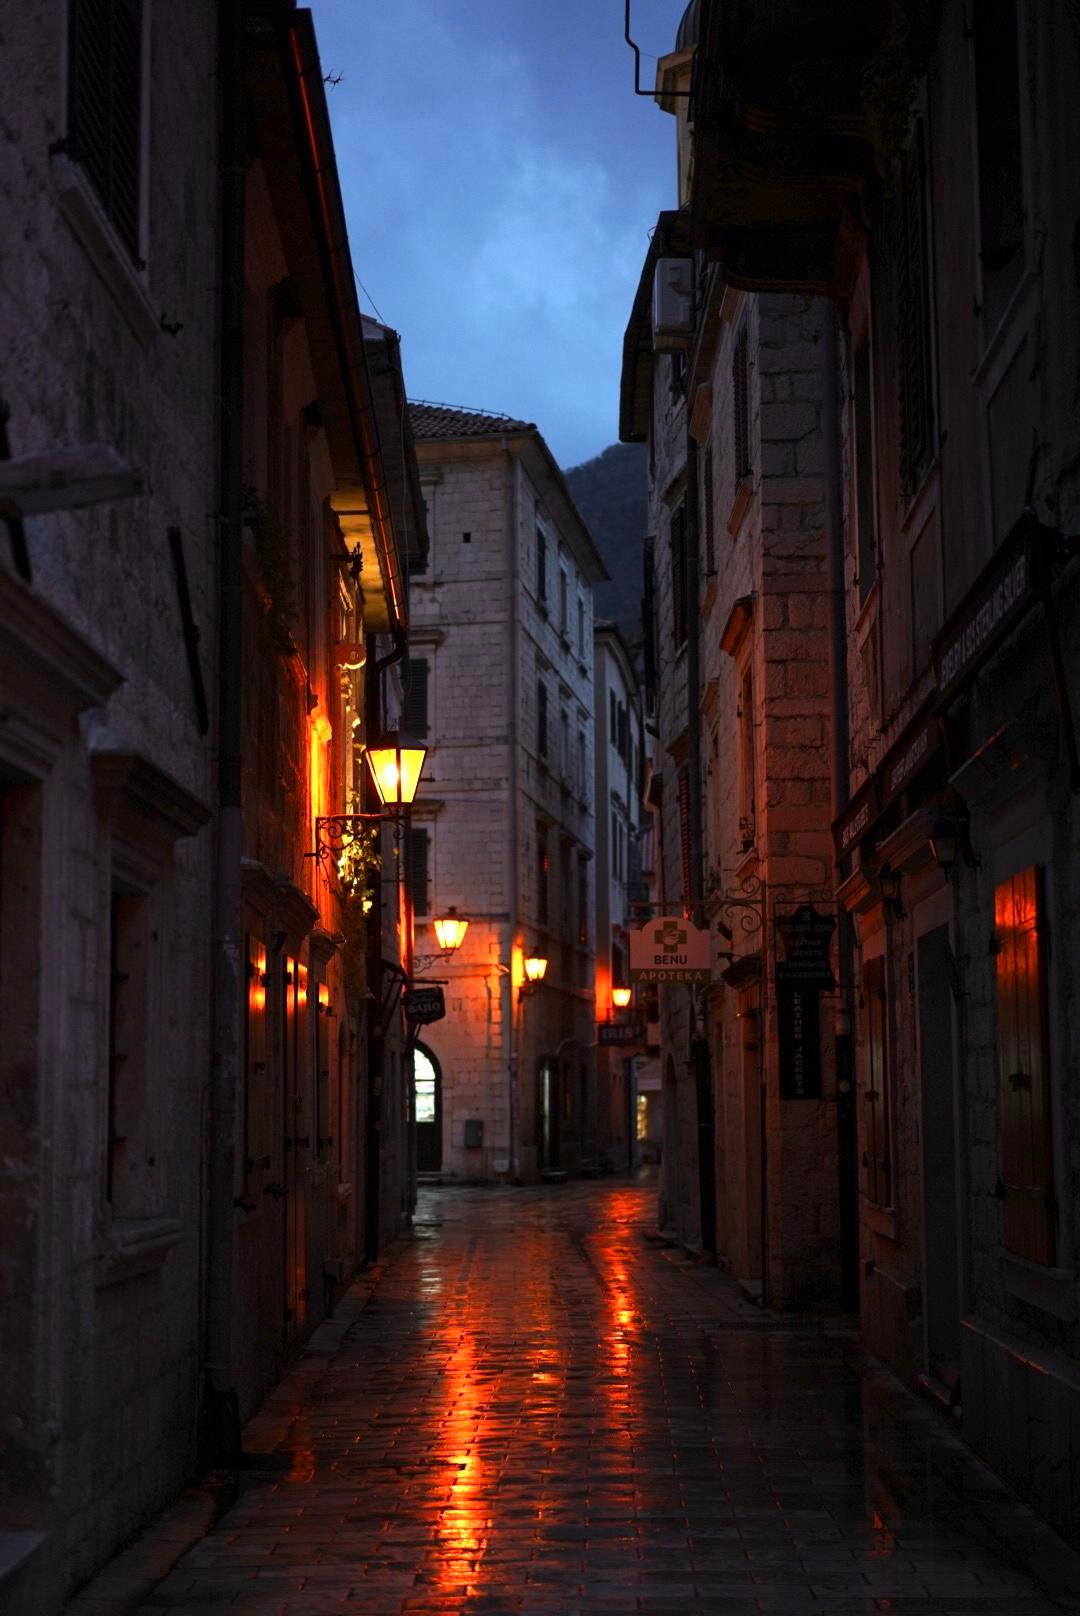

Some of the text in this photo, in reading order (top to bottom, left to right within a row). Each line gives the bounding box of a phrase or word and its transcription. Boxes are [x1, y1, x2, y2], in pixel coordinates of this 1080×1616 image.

[654, 955, 688, 966] BENU
[639, 971, 703, 983] APOTEKA
[793, 991, 806, 1095] LEATHER JACKETS
